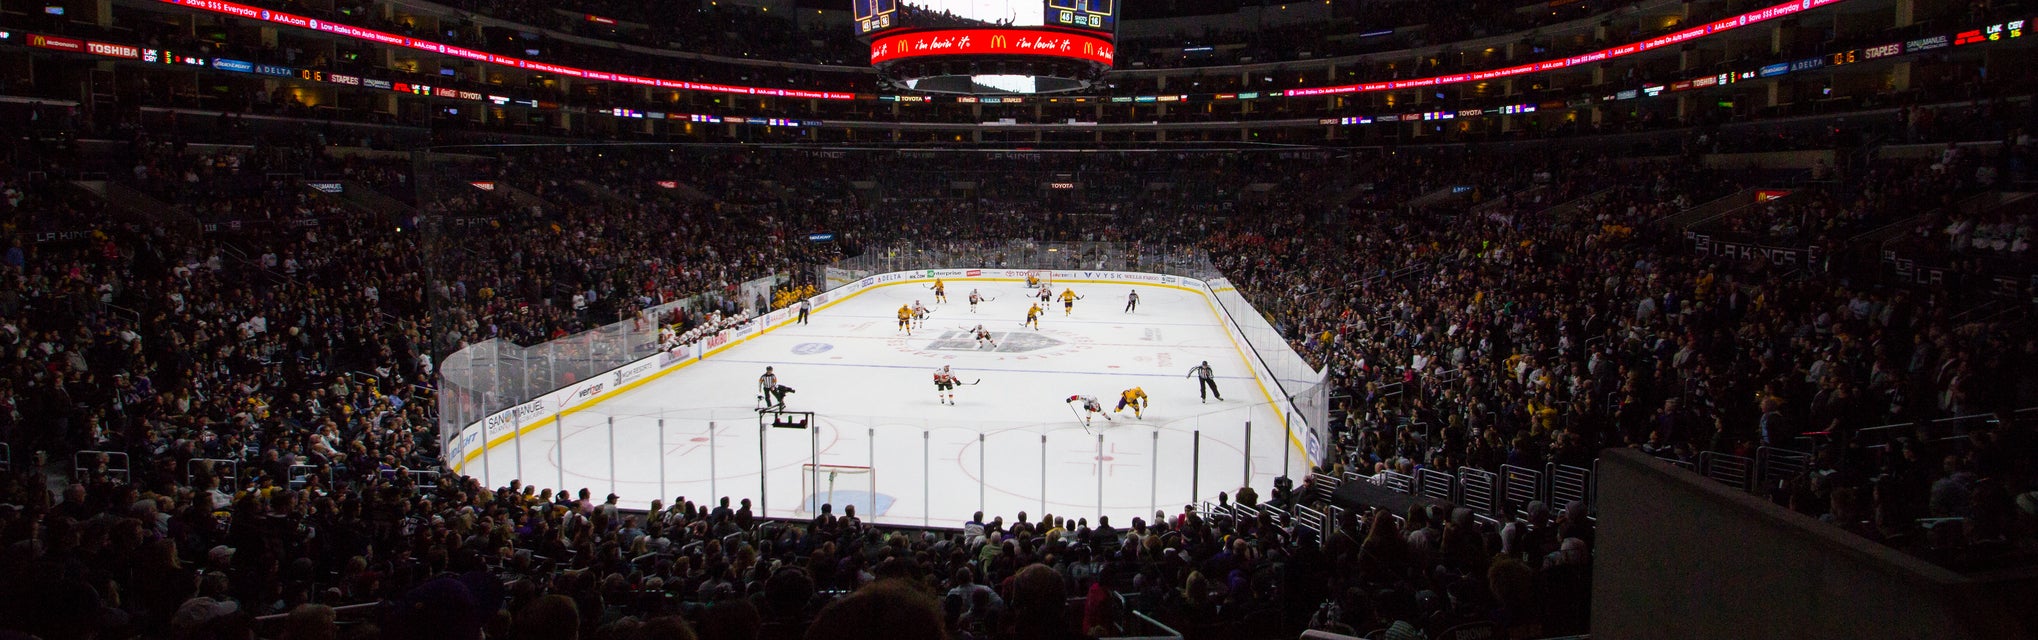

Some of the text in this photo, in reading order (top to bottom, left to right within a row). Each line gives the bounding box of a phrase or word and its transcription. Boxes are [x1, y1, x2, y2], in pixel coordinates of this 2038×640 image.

[223, 4, 258, 18] Everyday
[1748, 14, 1761, 22] Save
[1773, 3, 1799, 15] Everyday
[274, 14, 306, 27] AAA.com
[1714, 20, 1737, 31] AAA.com
[320, 23, 403, 45] Low Rates On Auto Insurance
[1682, 29, 1704, 39] Insurance
[1986, 23, 2003, 34] LAK
[2009, 28, 2022, 38] 16
[46, 40, 79, 50] McDonald's
[413, 41, 437, 51] AAA.com
[915, 38, 928, 50] i'm
[930, 36, 955, 51] lovin'
[1016, 37, 1031, 49] i'm
[1033, 36, 1058, 50] lovin'
[87, 43, 139, 58] TOSHIBA
[447, 47, 459, 55] Save
[468, 51, 487, 61] Everyday
[1614, 46, 1634, 55] AAA.com
[1865, 43, 1899, 59] STAPLES
[496, 56, 514, 65] AAA.com
[1542, 61, 1564, 69] AAA.com
[1798, 58, 1823, 69] DELTA
[264, 66, 292, 77] DELTA
[331, 74, 359, 86] STAPLES
[1693, 76, 1717, 87] TOSHIBA
[459, 91, 482, 101] TOYOTA
[1458, 109, 1482, 117] TOYOTA
[59, 230, 92, 241] KING
[881, 273, 902, 282] DELTA
[706, 331, 728, 350] HARIBO
[578, 382, 604, 398] verizon
[488, 412, 505, 430] SAN
